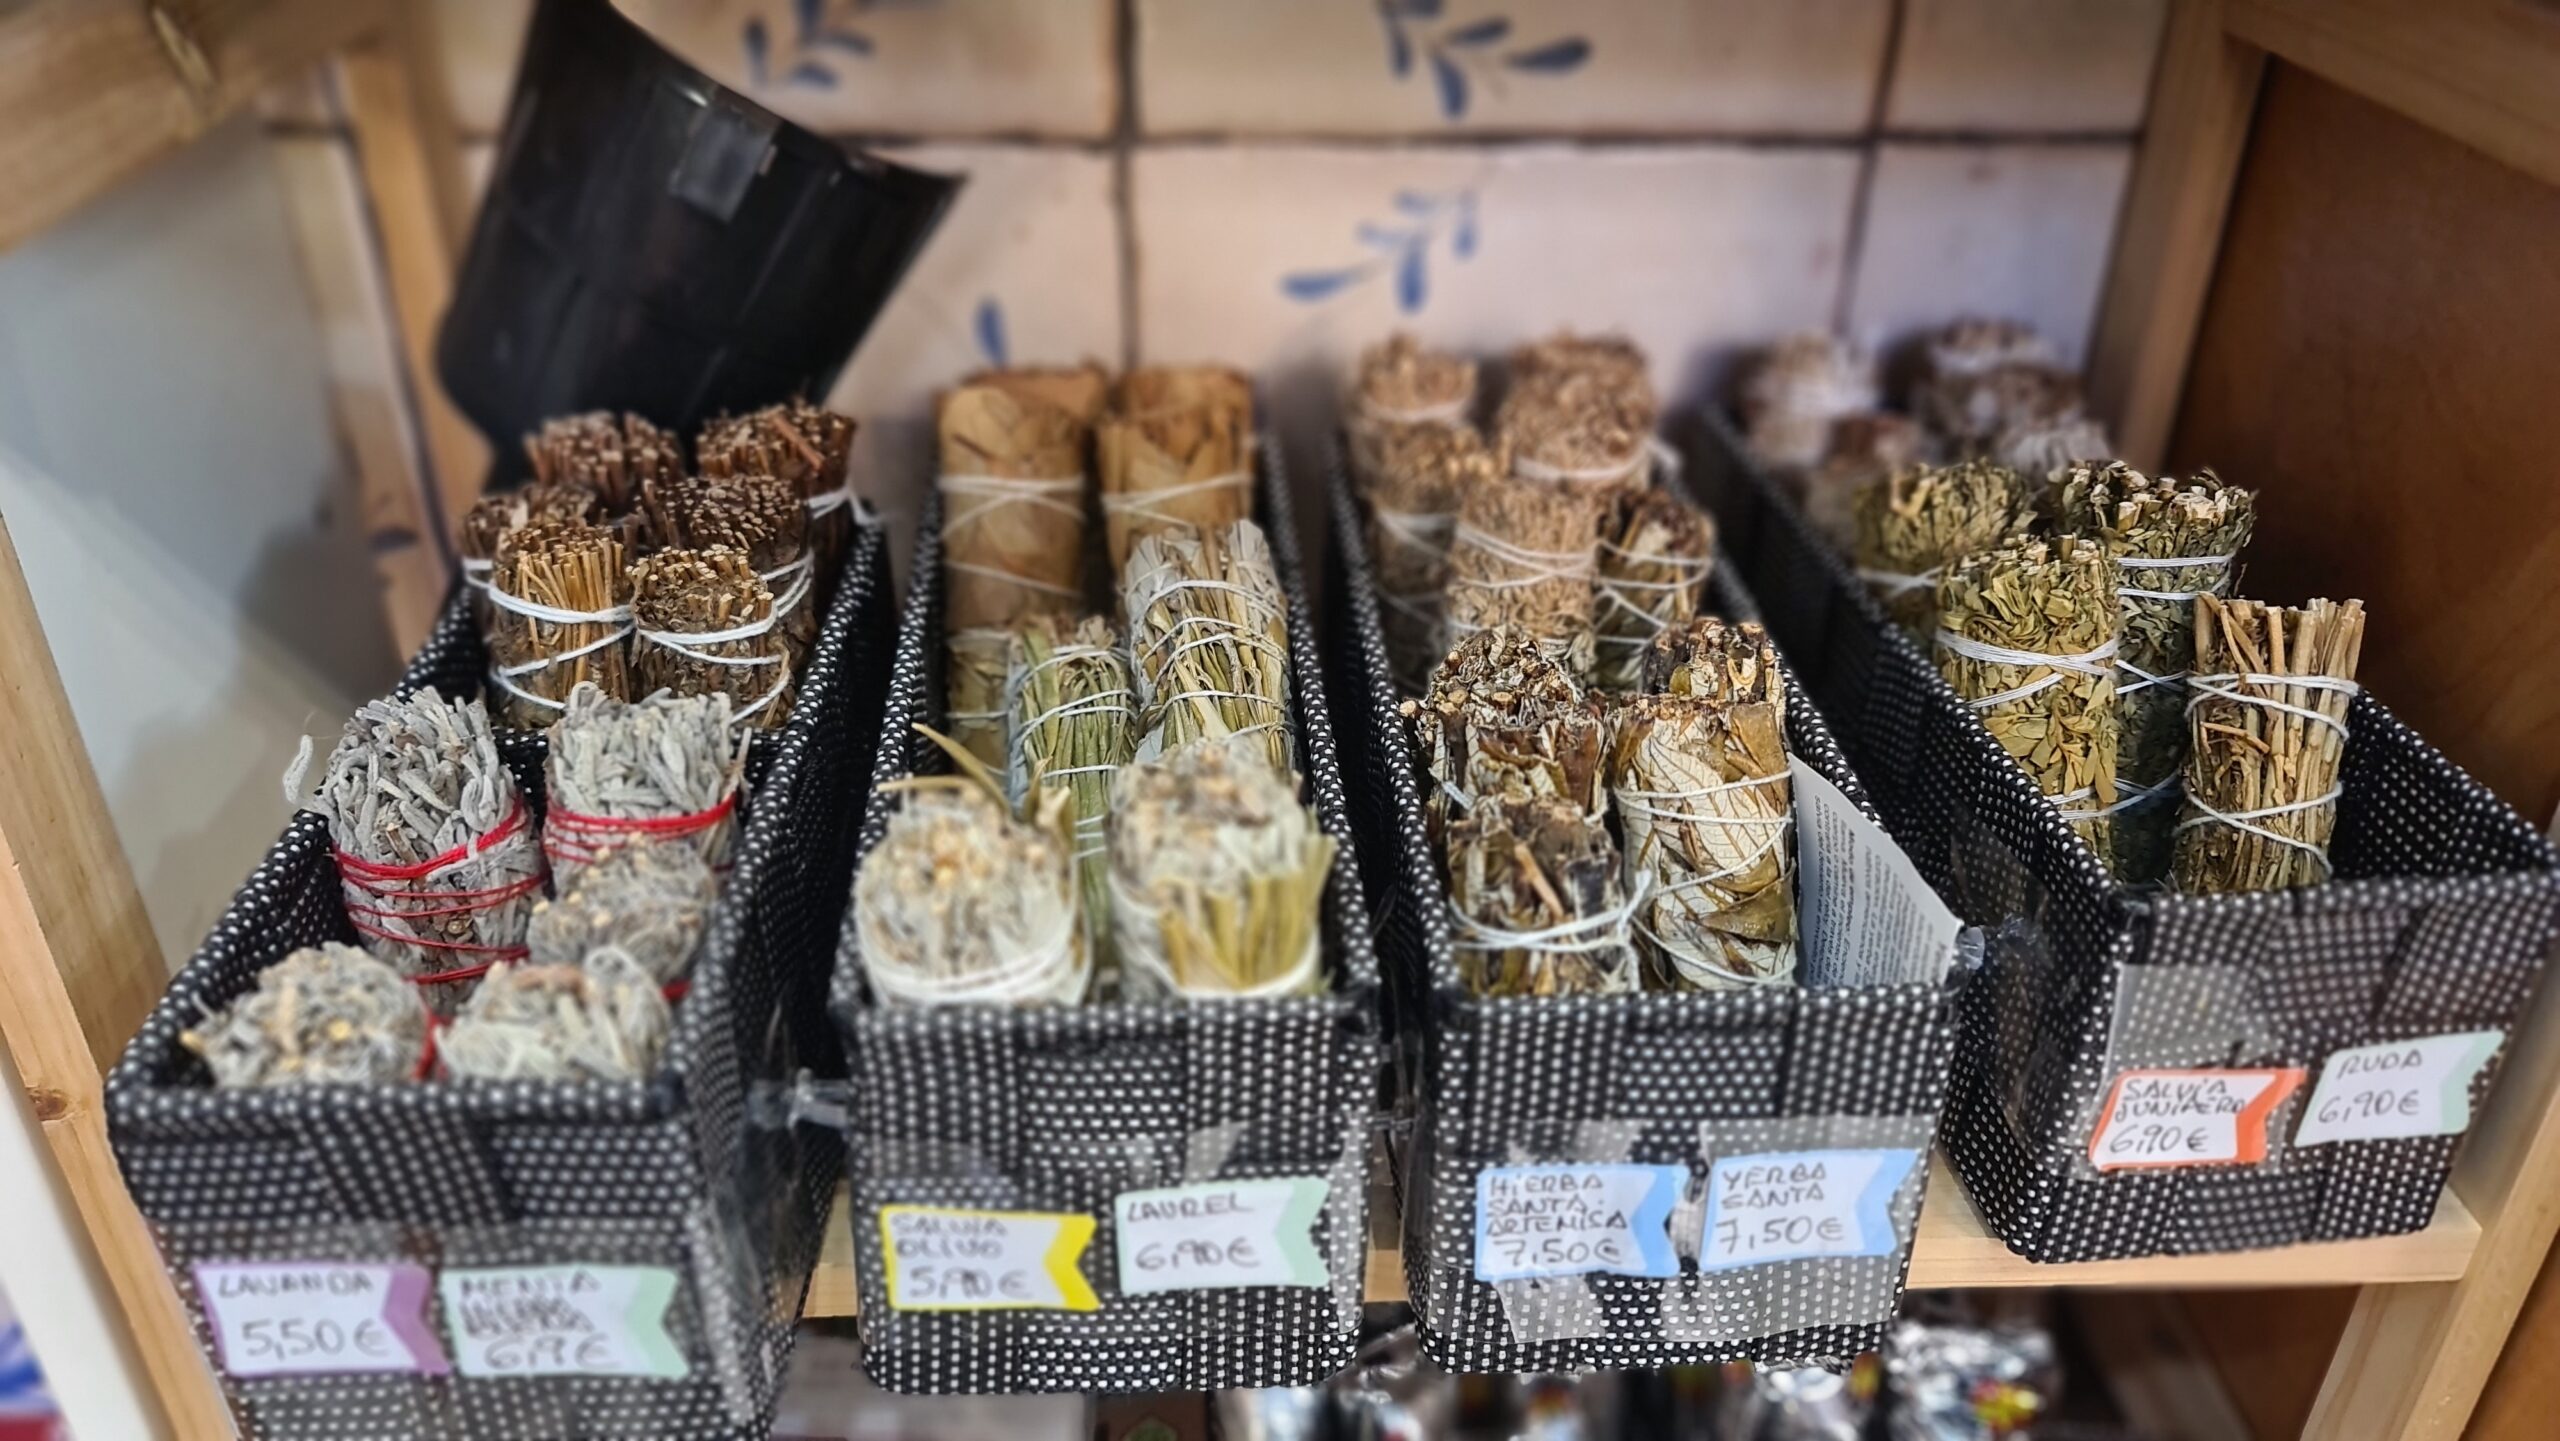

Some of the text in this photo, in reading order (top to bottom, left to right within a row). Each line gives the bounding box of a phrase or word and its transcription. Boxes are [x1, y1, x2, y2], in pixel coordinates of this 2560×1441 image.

[2336, 1048, 2423, 1080] RUDA
[2318, 1088, 2421, 1124] 6,90€
[2109, 1124, 2210, 1155] 6,90€
[1722, 1161, 1827, 1191] YERBA
[1127, 1191, 1255, 1223] LAUREL
[1720, 1182, 1825, 1211] SANTA
[1715, 1216, 1844, 1256] 7,50€
[1135, 1236, 1262, 1272] 6,90€
[1493, 1238, 1623, 1267] 7,50€
[218, 1270, 375, 1299] LAVANDA
[242, 1317, 391, 1360] 5,50€
